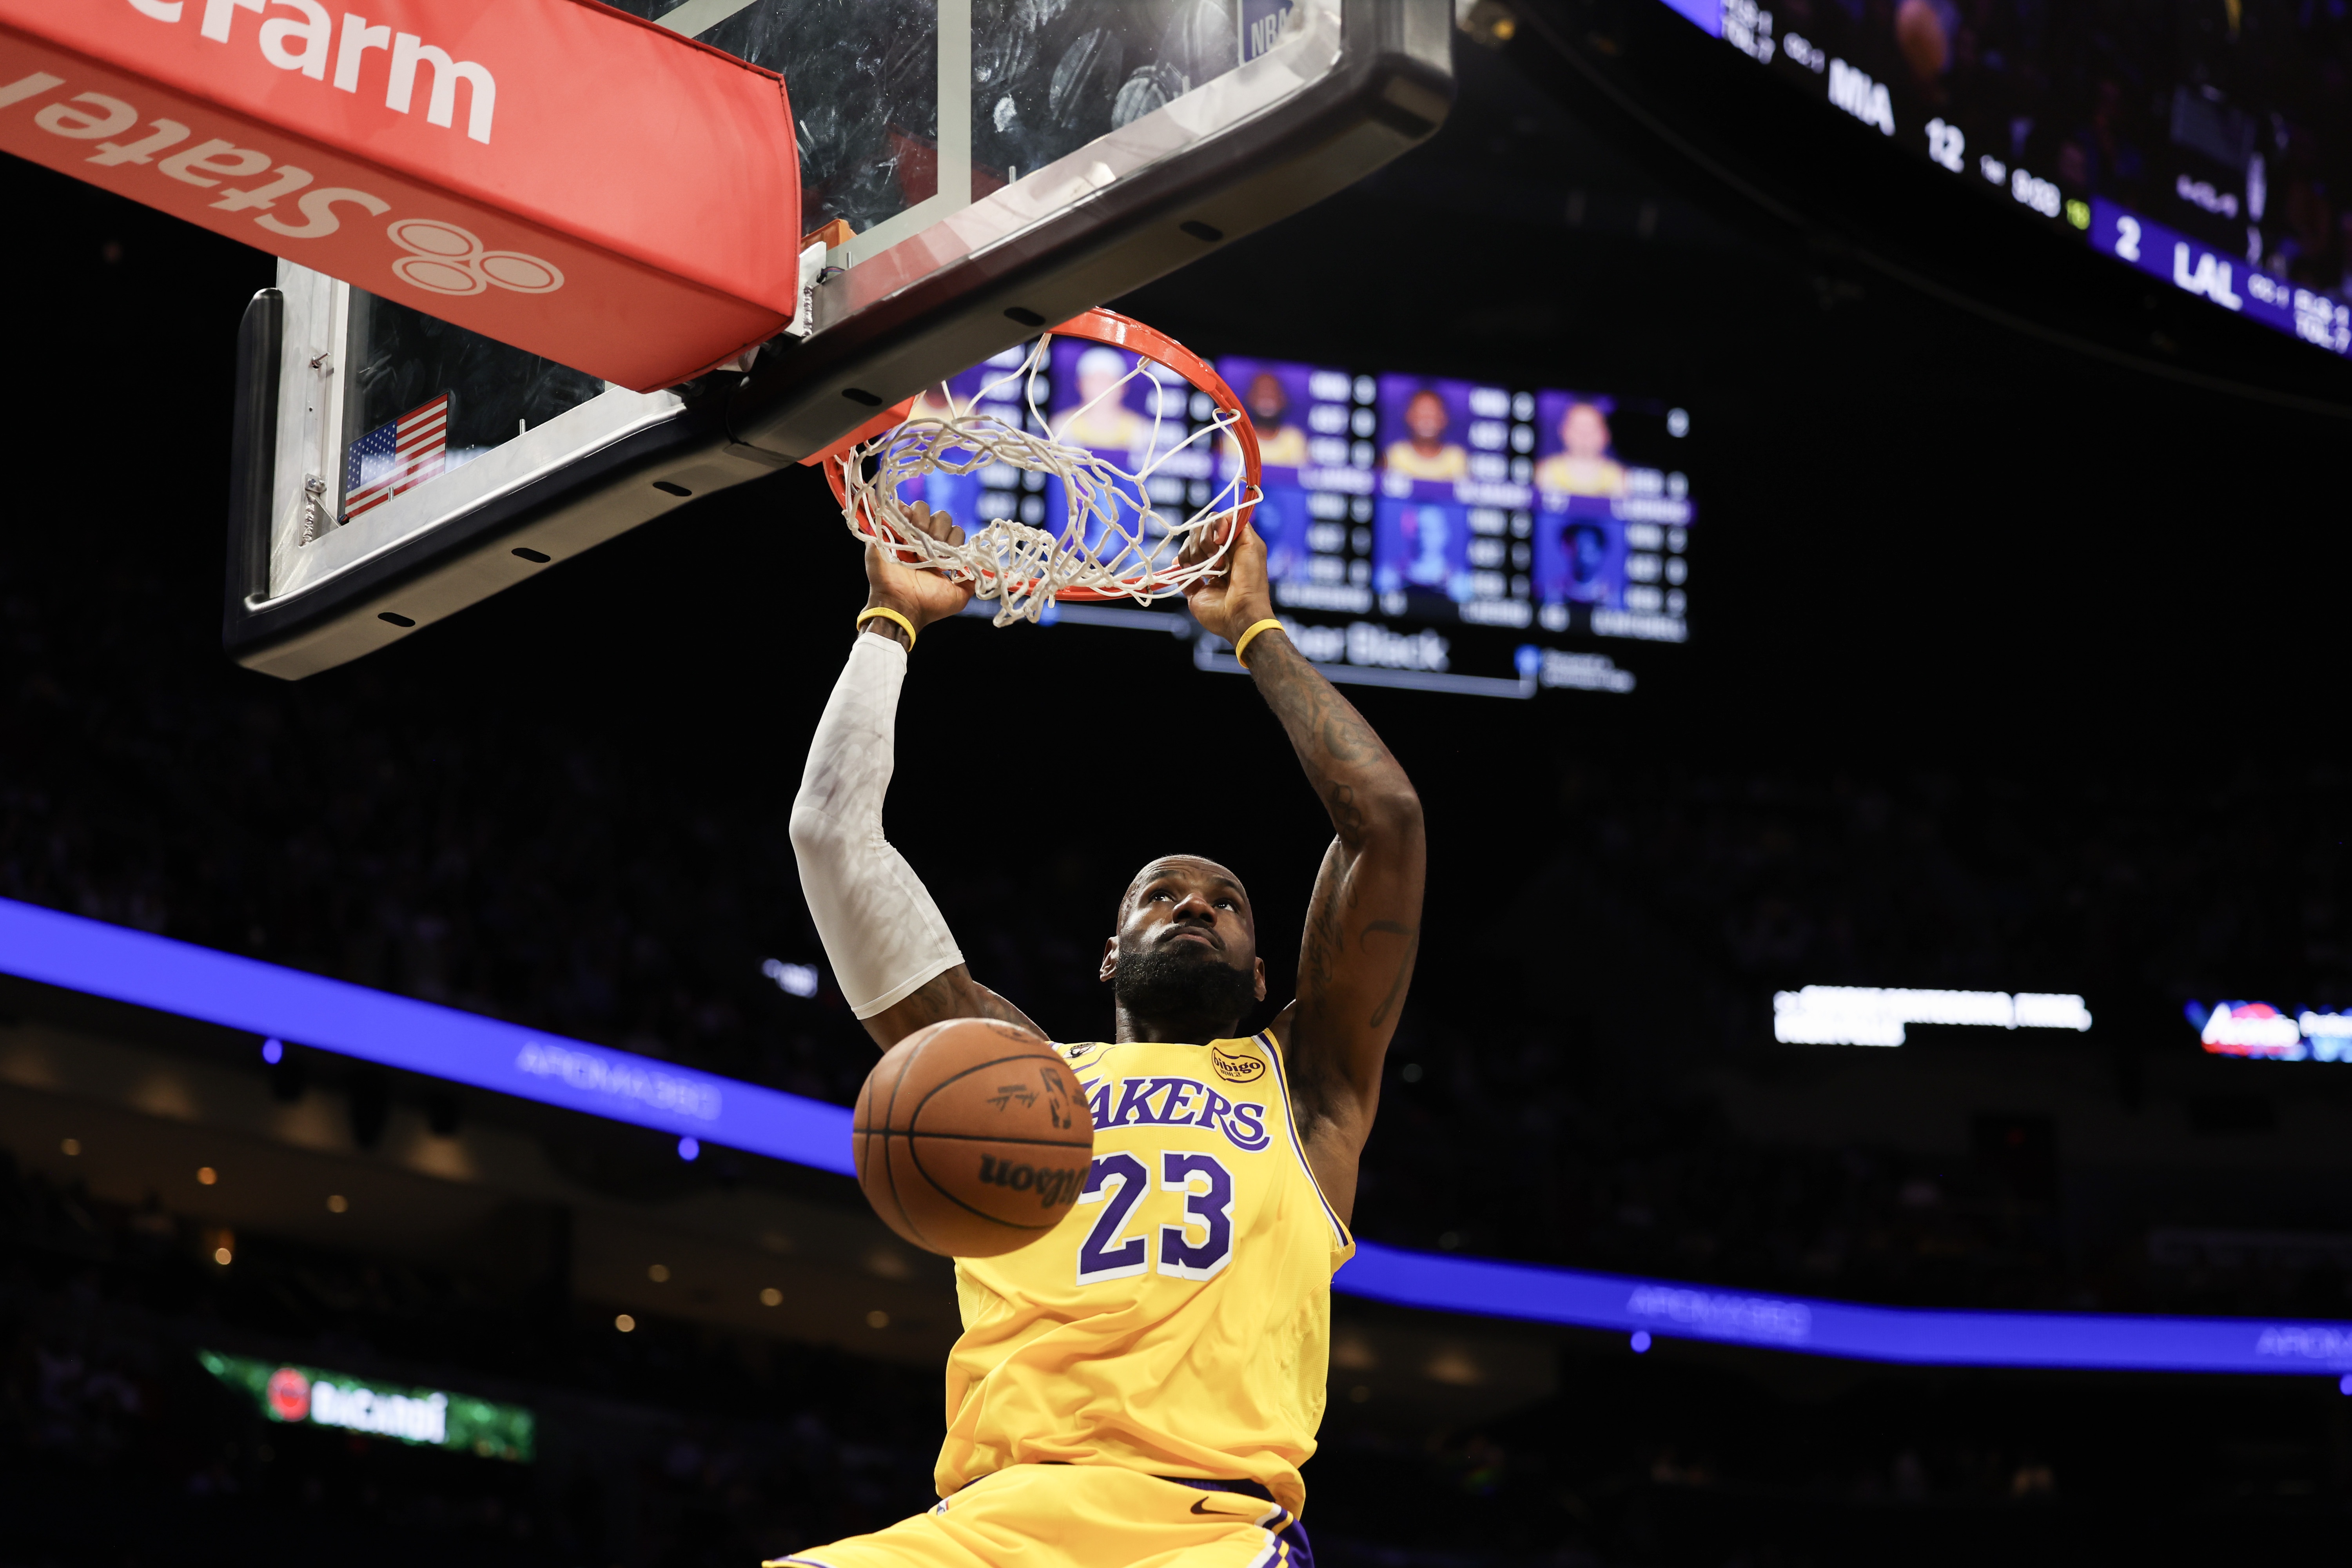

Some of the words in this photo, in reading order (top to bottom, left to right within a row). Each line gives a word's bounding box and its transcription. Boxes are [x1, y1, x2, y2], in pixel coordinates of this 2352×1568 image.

[35, 92, 392, 239] State
[2116, 216, 2141, 262] 2
[2173, 241, 2243, 312] LAL
[1214, 1052, 1261, 1074] bibigo
[1220, 1069, 1242, 1077] 비비고
[1076, 1149, 1235, 1287] 23
